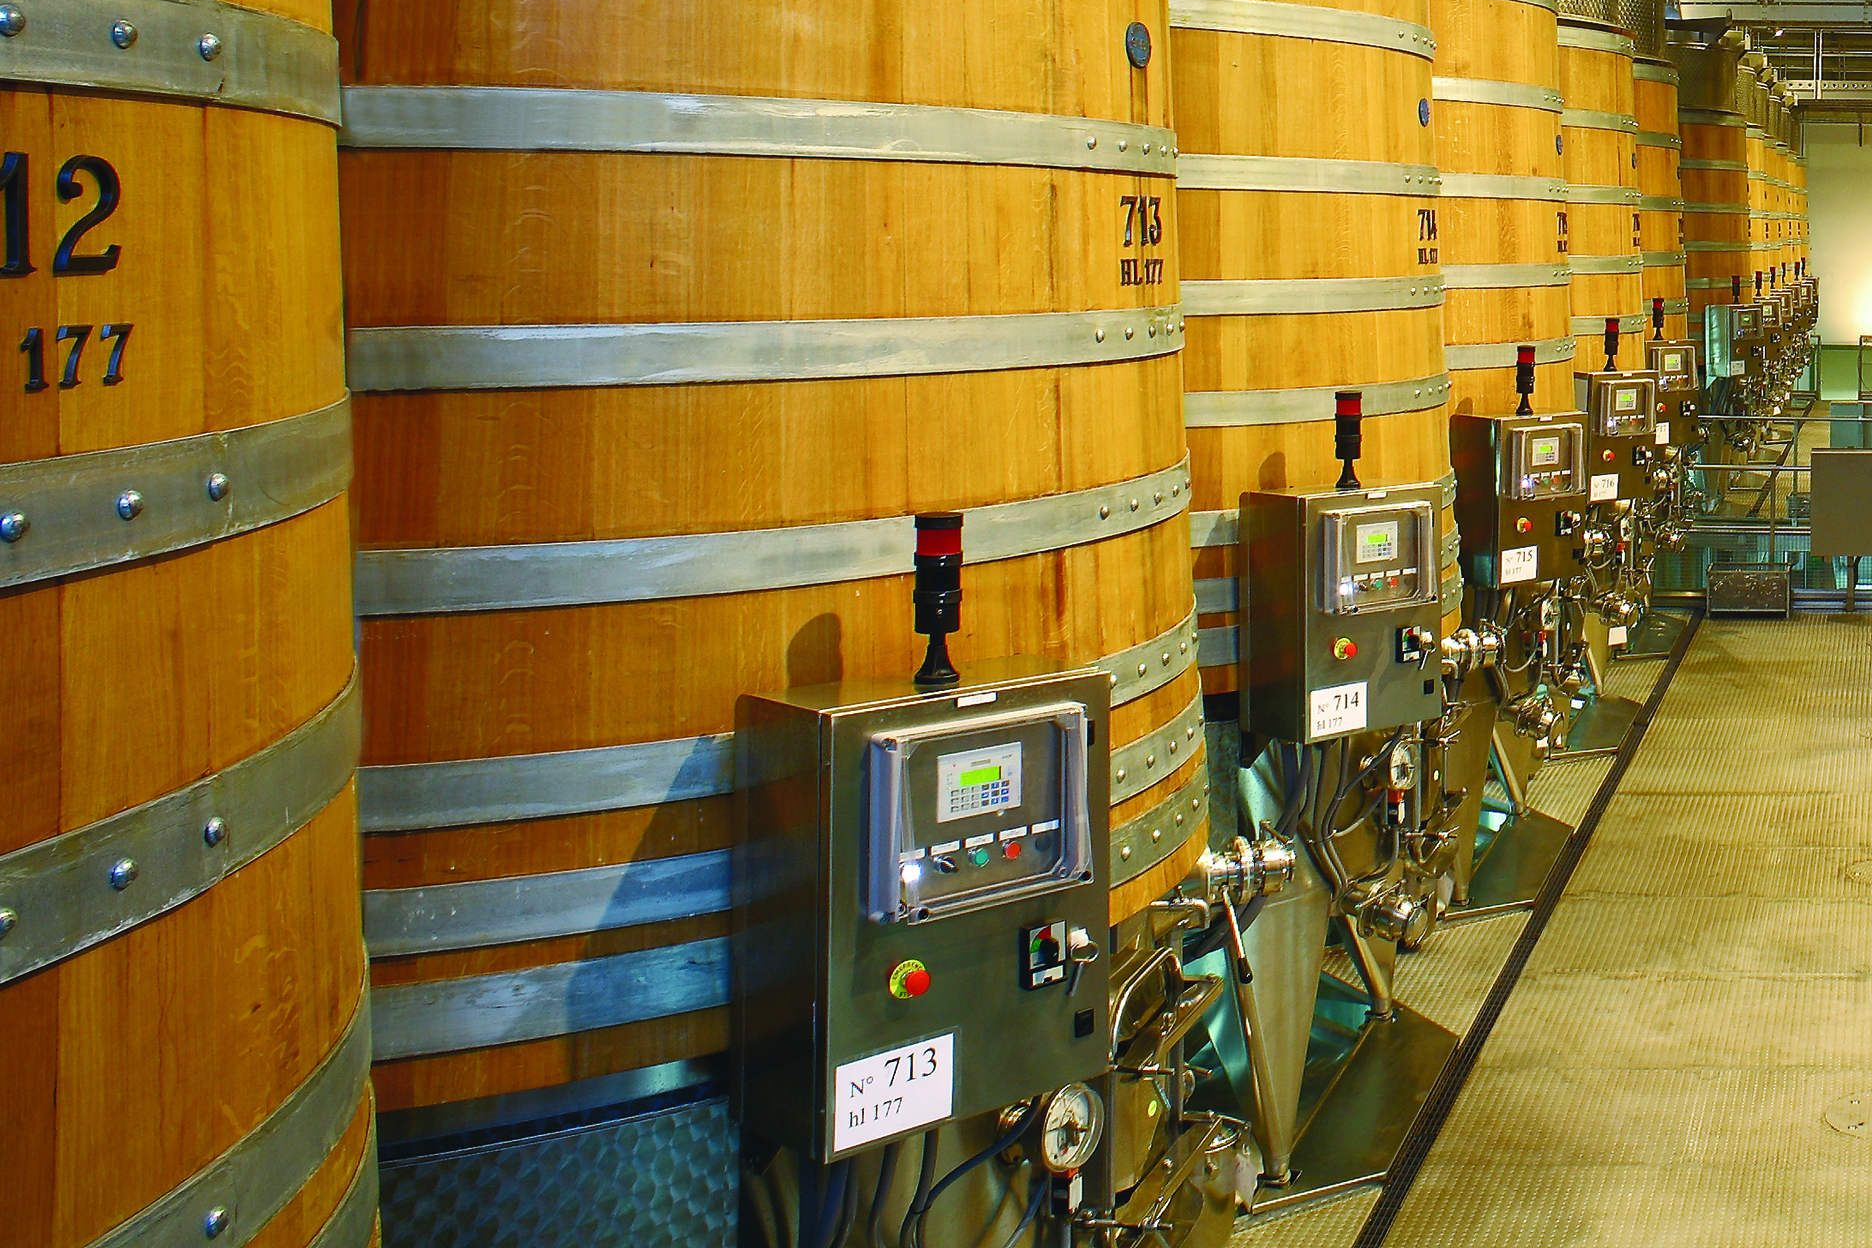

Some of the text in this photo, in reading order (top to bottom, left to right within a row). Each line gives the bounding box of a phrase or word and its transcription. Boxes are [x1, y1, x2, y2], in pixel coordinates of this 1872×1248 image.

[1119, 195, 1162, 247] 713
[1120, 259, 1142, 286] HL
[20, 324, 134, 393] 177
[1516, 549, 1533, 563] 715
[1333, 691, 1359, 711] 714
[1328, 716, 1343, 728] 177
[884, 1047, 937, 1088] 713
[848, 1096, 903, 1129] hl 177
